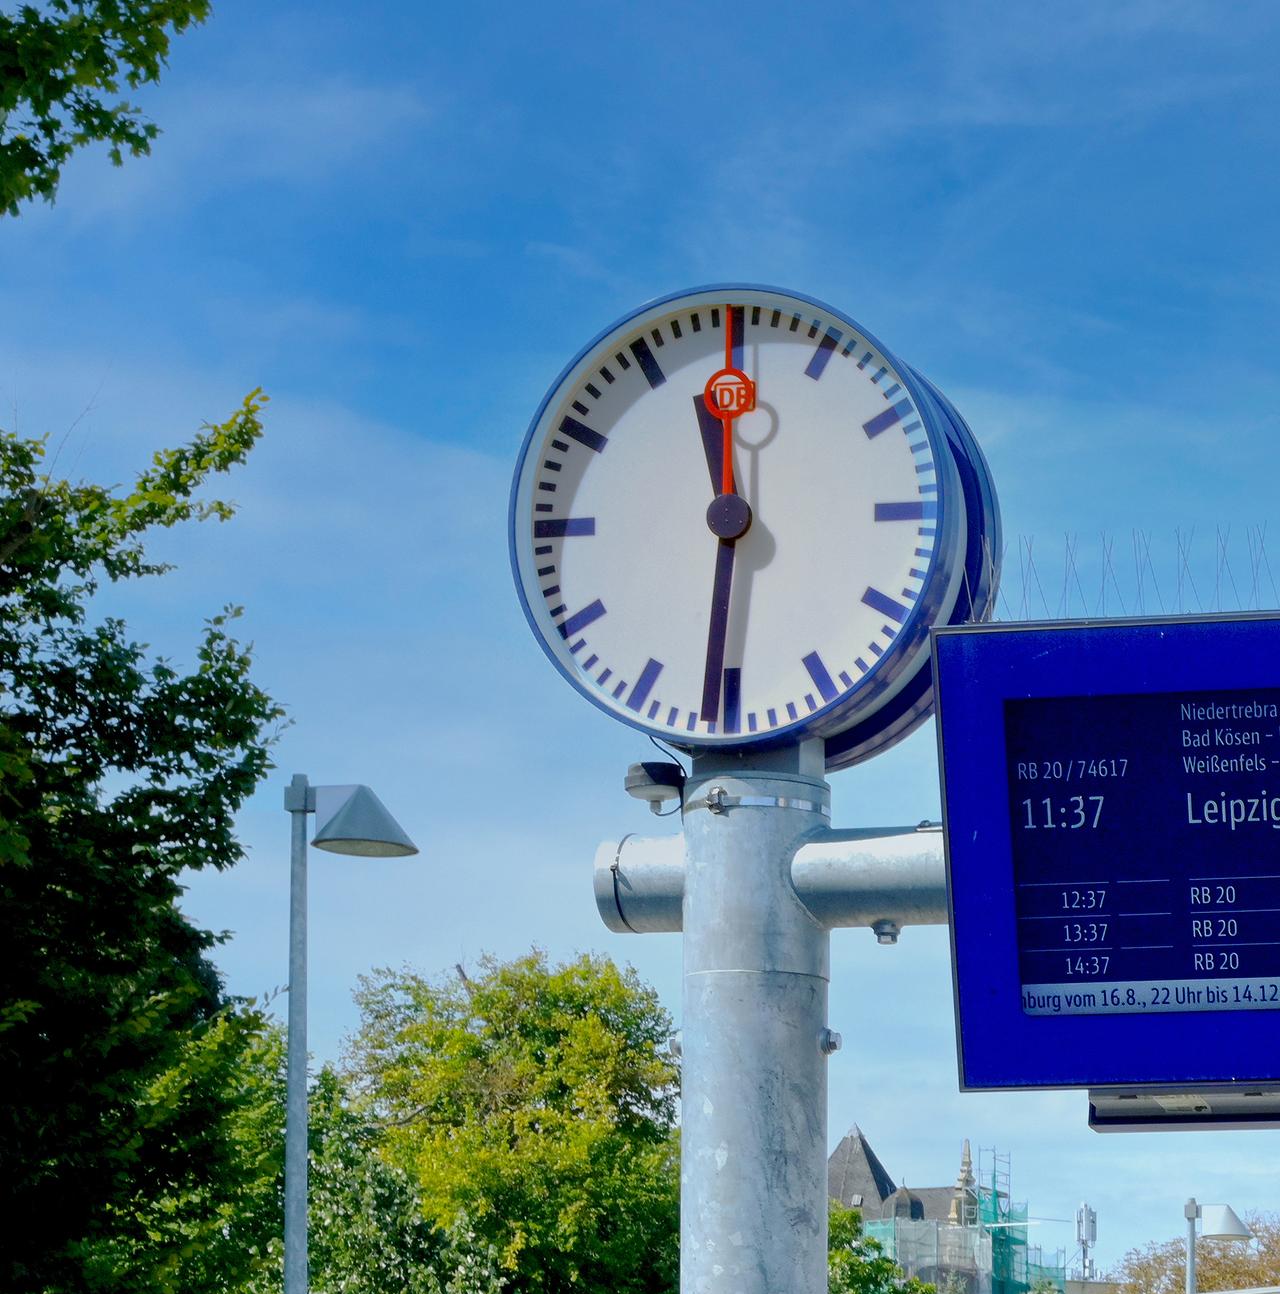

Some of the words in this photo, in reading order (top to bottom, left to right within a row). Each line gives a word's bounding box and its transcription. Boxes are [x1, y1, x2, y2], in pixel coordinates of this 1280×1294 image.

[1181, 701, 1277, 720] Niedertrebra
[1183, 729, 1209, 747] Bad
[1215, 729, 1259, 745] Kösen
[1019, 763, 1037, 779] RB
[1183, 754, 1266, 773] Weißenfels
[1023, 796, 1104, 828] 11:37
[1063, 891, 1105, 908] 12:37
[1191, 887, 1210, 904] RB
[1217, 886, 1235, 903] 20
[1064, 924, 1107, 941] 13:37
[1193, 920, 1212, 937] RB
[1218, 920, 1237, 936] 20
[1066, 957, 1109, 974] 14:37
[1195, 953, 1214, 970] RB
[1220, 953, 1238, 969] 20
[1065, 995, 1095, 1008] vom
[1101, 989, 1146, 1008] 16.8.,
[1151, 988, 1170, 1005] 22
[1176, 987, 1202, 1004] Uhr
[1207, 986, 1228, 1003] bis
